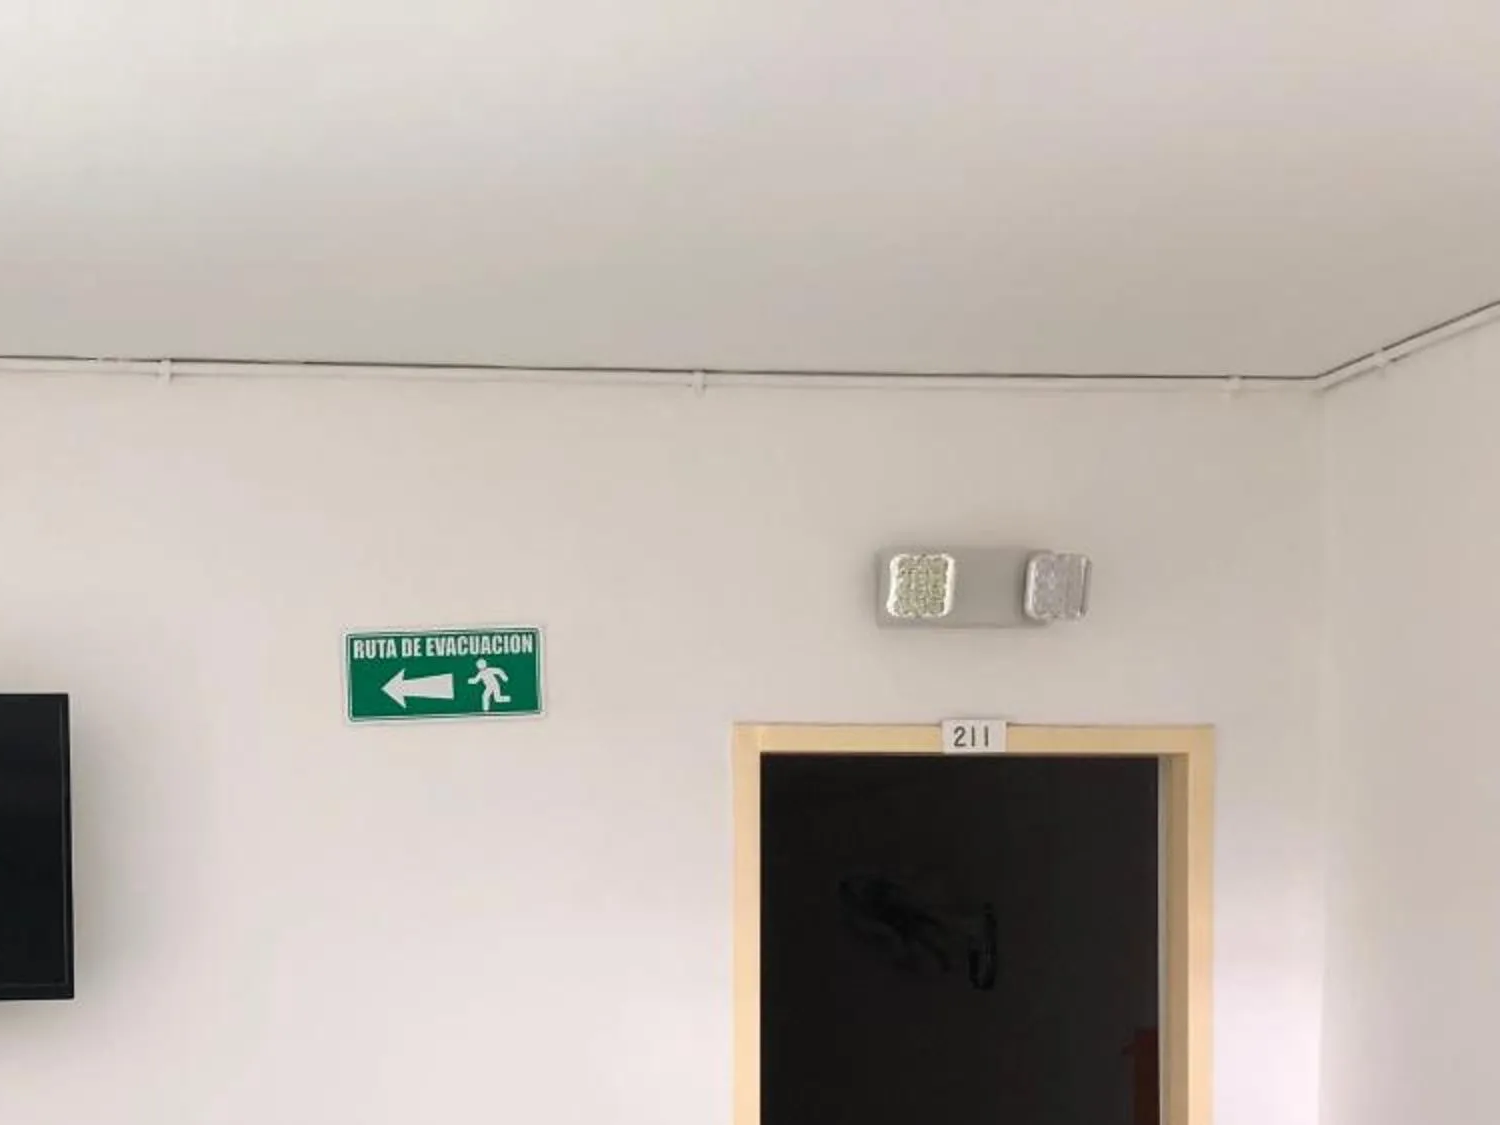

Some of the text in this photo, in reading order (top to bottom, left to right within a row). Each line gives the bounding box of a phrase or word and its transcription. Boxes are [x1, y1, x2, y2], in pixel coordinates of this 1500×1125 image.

[353, 634, 533, 659] RUTA DE EVACUACION
[953, 726, 989, 747] 211
